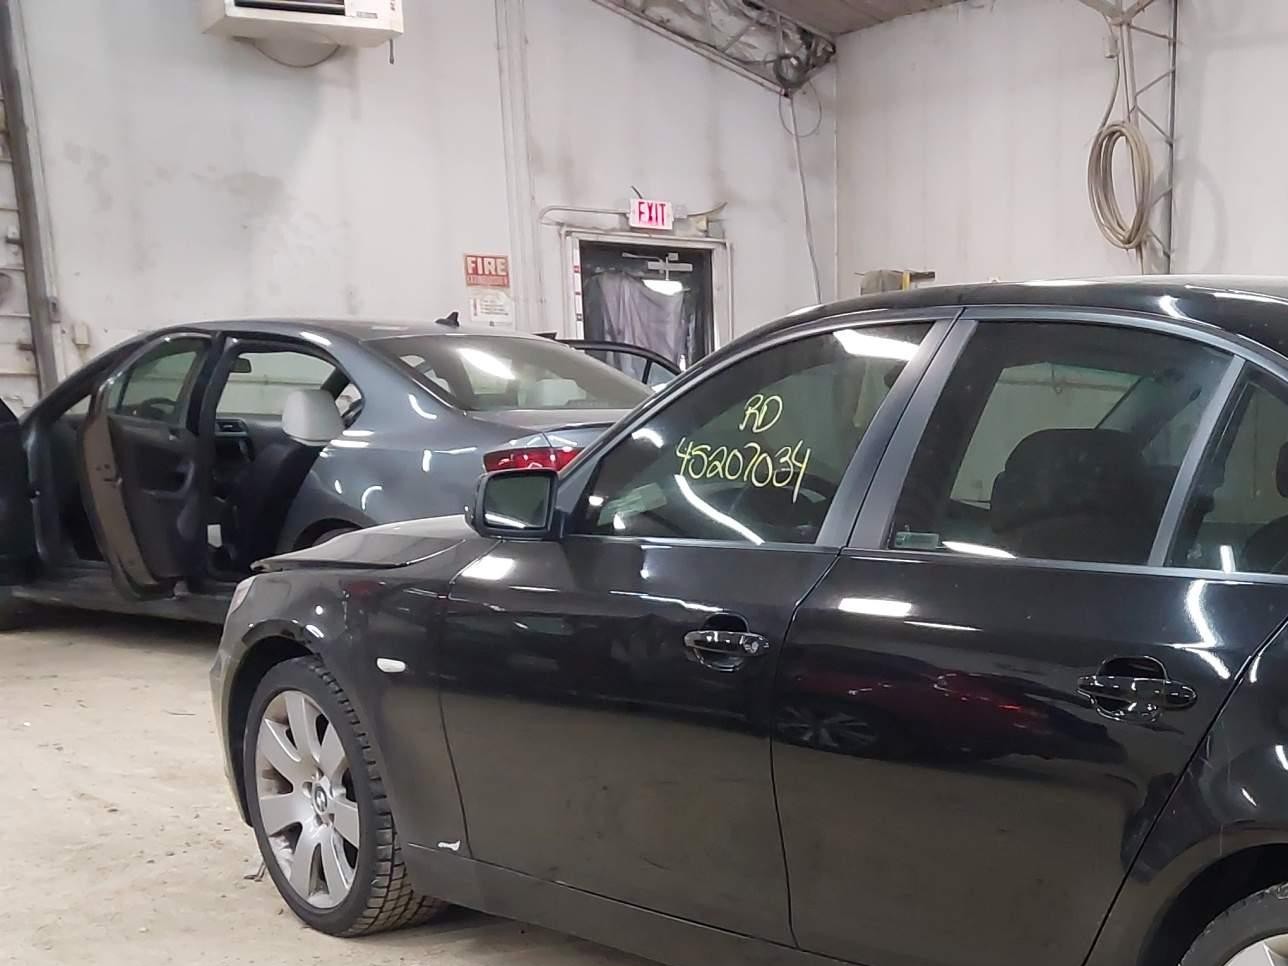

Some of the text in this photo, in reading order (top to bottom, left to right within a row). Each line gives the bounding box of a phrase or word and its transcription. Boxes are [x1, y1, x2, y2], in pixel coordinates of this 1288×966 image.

[638, 201, 666, 225] EXIT
[466, 256, 507, 275] FIRE
[739, 394, 783, 432] RD
[676, 437, 811, 503] 45207034
